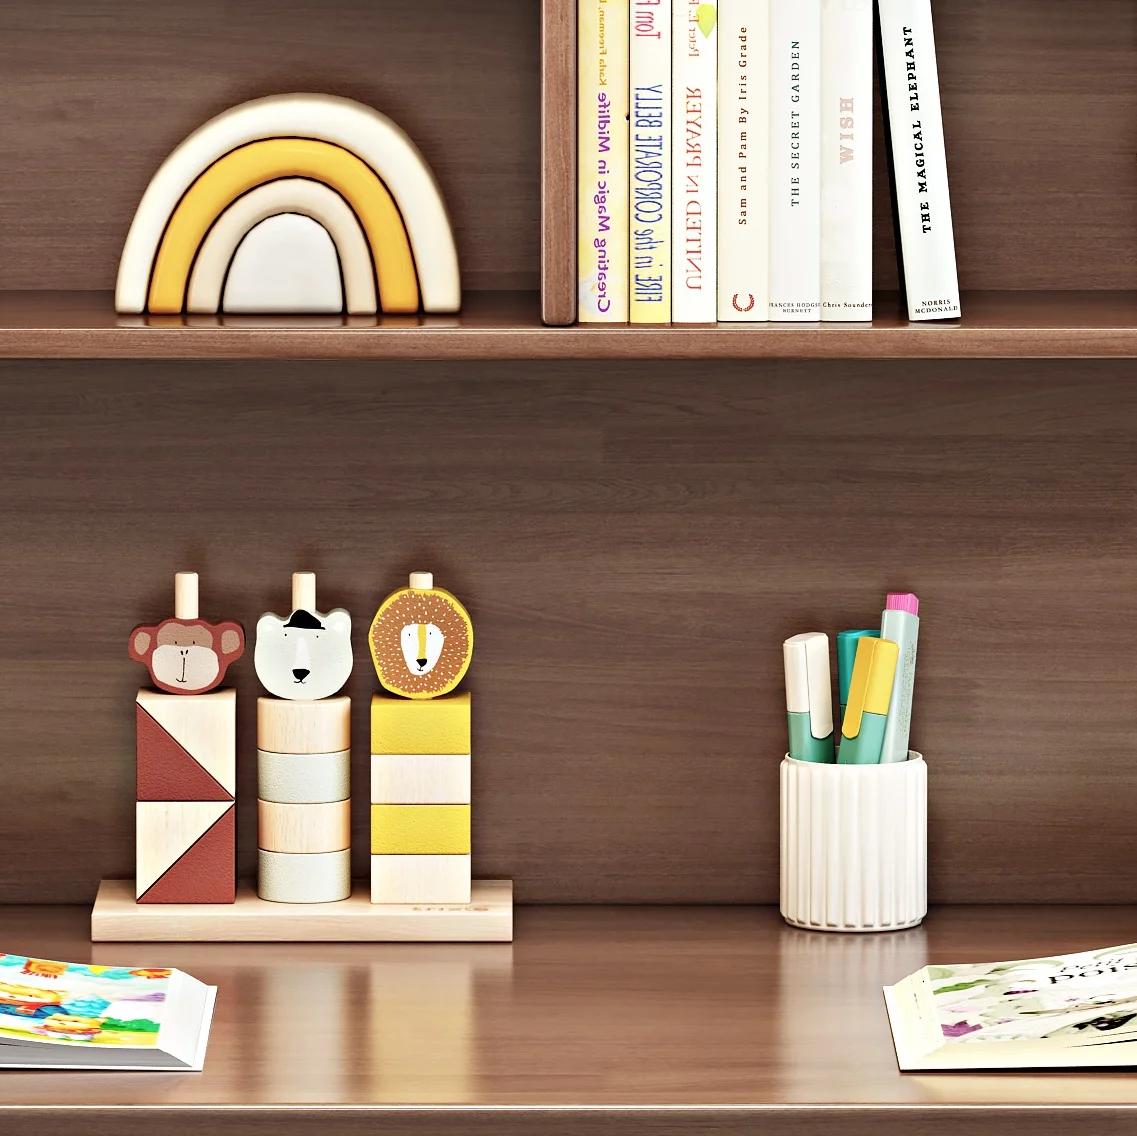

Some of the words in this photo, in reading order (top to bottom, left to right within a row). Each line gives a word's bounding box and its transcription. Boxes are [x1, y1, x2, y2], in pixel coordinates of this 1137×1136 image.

[738, 27, 747, 68] Grade
[791, 41, 800, 103] GARDEN
[902, 26, 920, 112] ELEPHANT
[738, 75, 747, 100] Iris
[738, 107, 749, 124] By
[738, 131, 747, 159] Pam
[791, 110, 800, 170] SECRET
[840, 97, 855, 165] WISH
[915, 120, 928, 194] MAGICAL
[737, 166, 747, 191] and
[791, 177, 800, 207] THE
[738, 198, 747, 225] Sam
[920, 201, 932, 234] THE
[914, 305, 959, 314] MCDONALD
[921, 299, 951, 307] NORRIS
